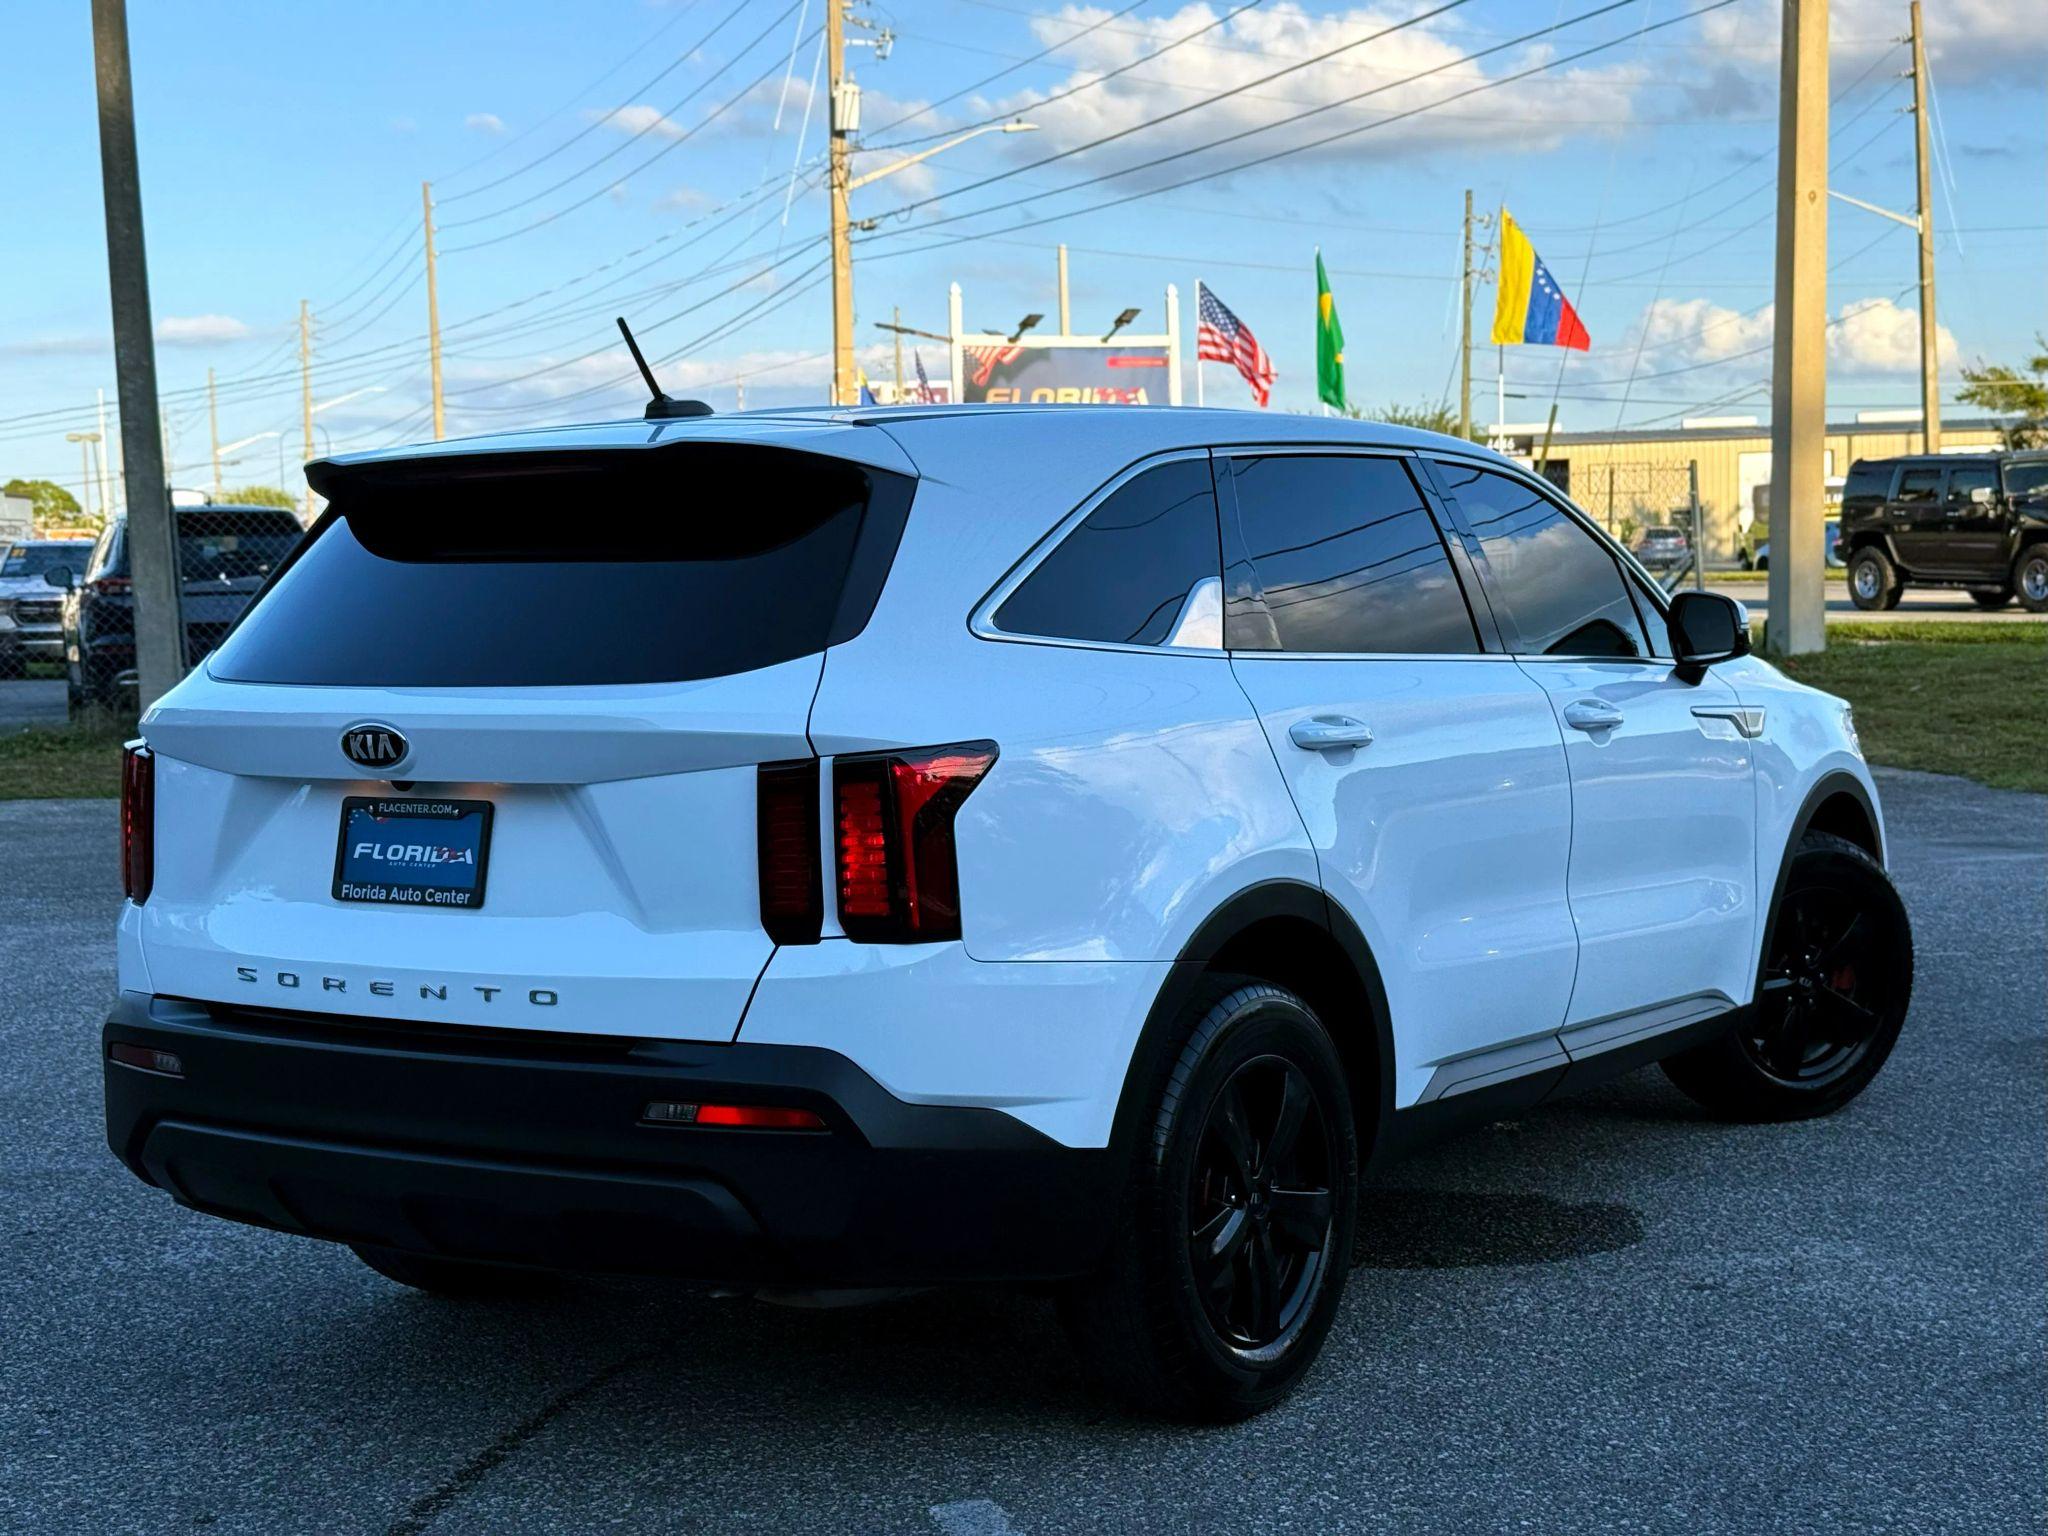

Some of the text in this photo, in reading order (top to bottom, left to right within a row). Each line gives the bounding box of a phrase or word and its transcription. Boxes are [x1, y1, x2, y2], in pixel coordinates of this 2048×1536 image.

[349, 733, 397, 760] KIA
[378, 802, 452, 815] FLACENTER.COM
[353, 842, 473, 865] FLORIDA
[341, 884, 471, 905] Florida Auto Center
[237, 966, 558, 1006] SORENTO
